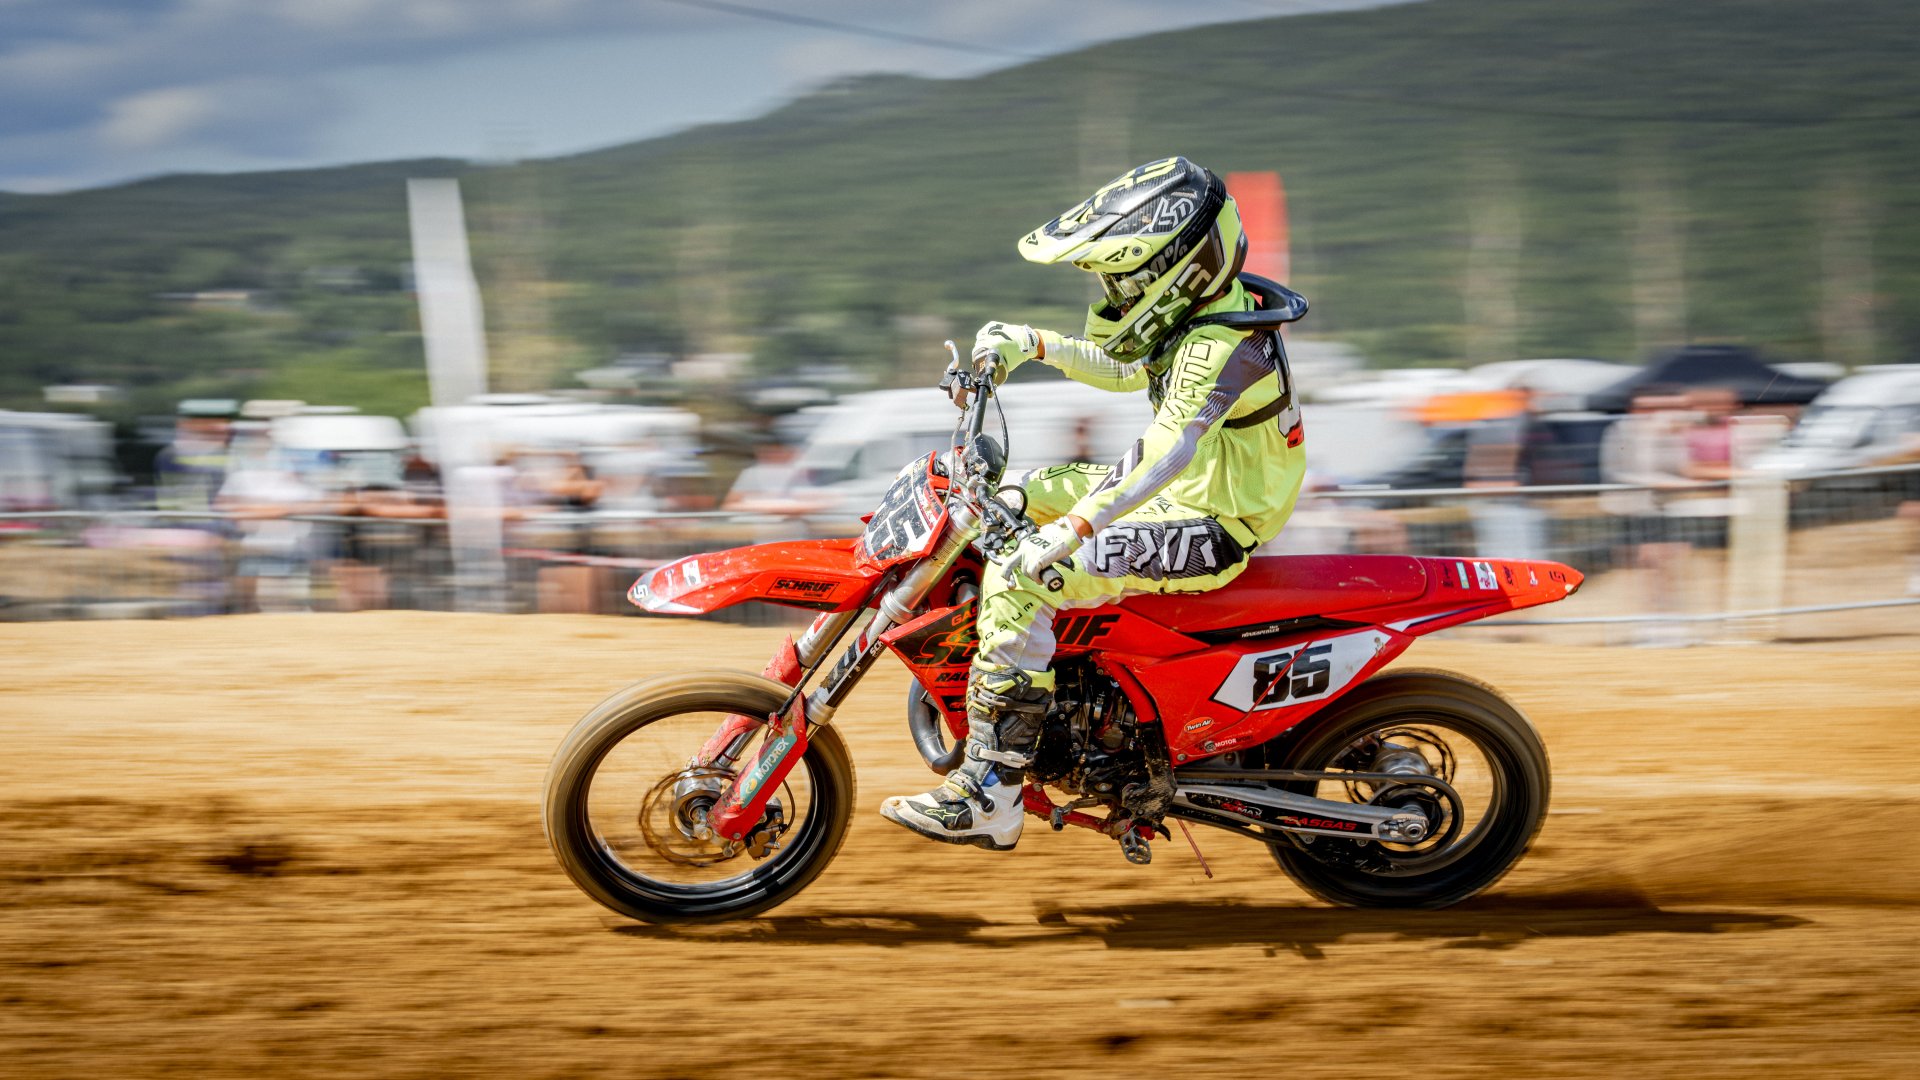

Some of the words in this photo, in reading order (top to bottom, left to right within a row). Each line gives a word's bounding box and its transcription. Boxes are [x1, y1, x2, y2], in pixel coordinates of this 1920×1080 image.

[774, 579, 835, 592] SCHRUF
[1253, 643, 1332, 706] 85
[1186, 723, 1202, 732] Twin
[1201, 719, 1213, 728] Air
[756, 738, 789, 780] MOTOREX
[1284, 815, 1358, 831] GASGAS
